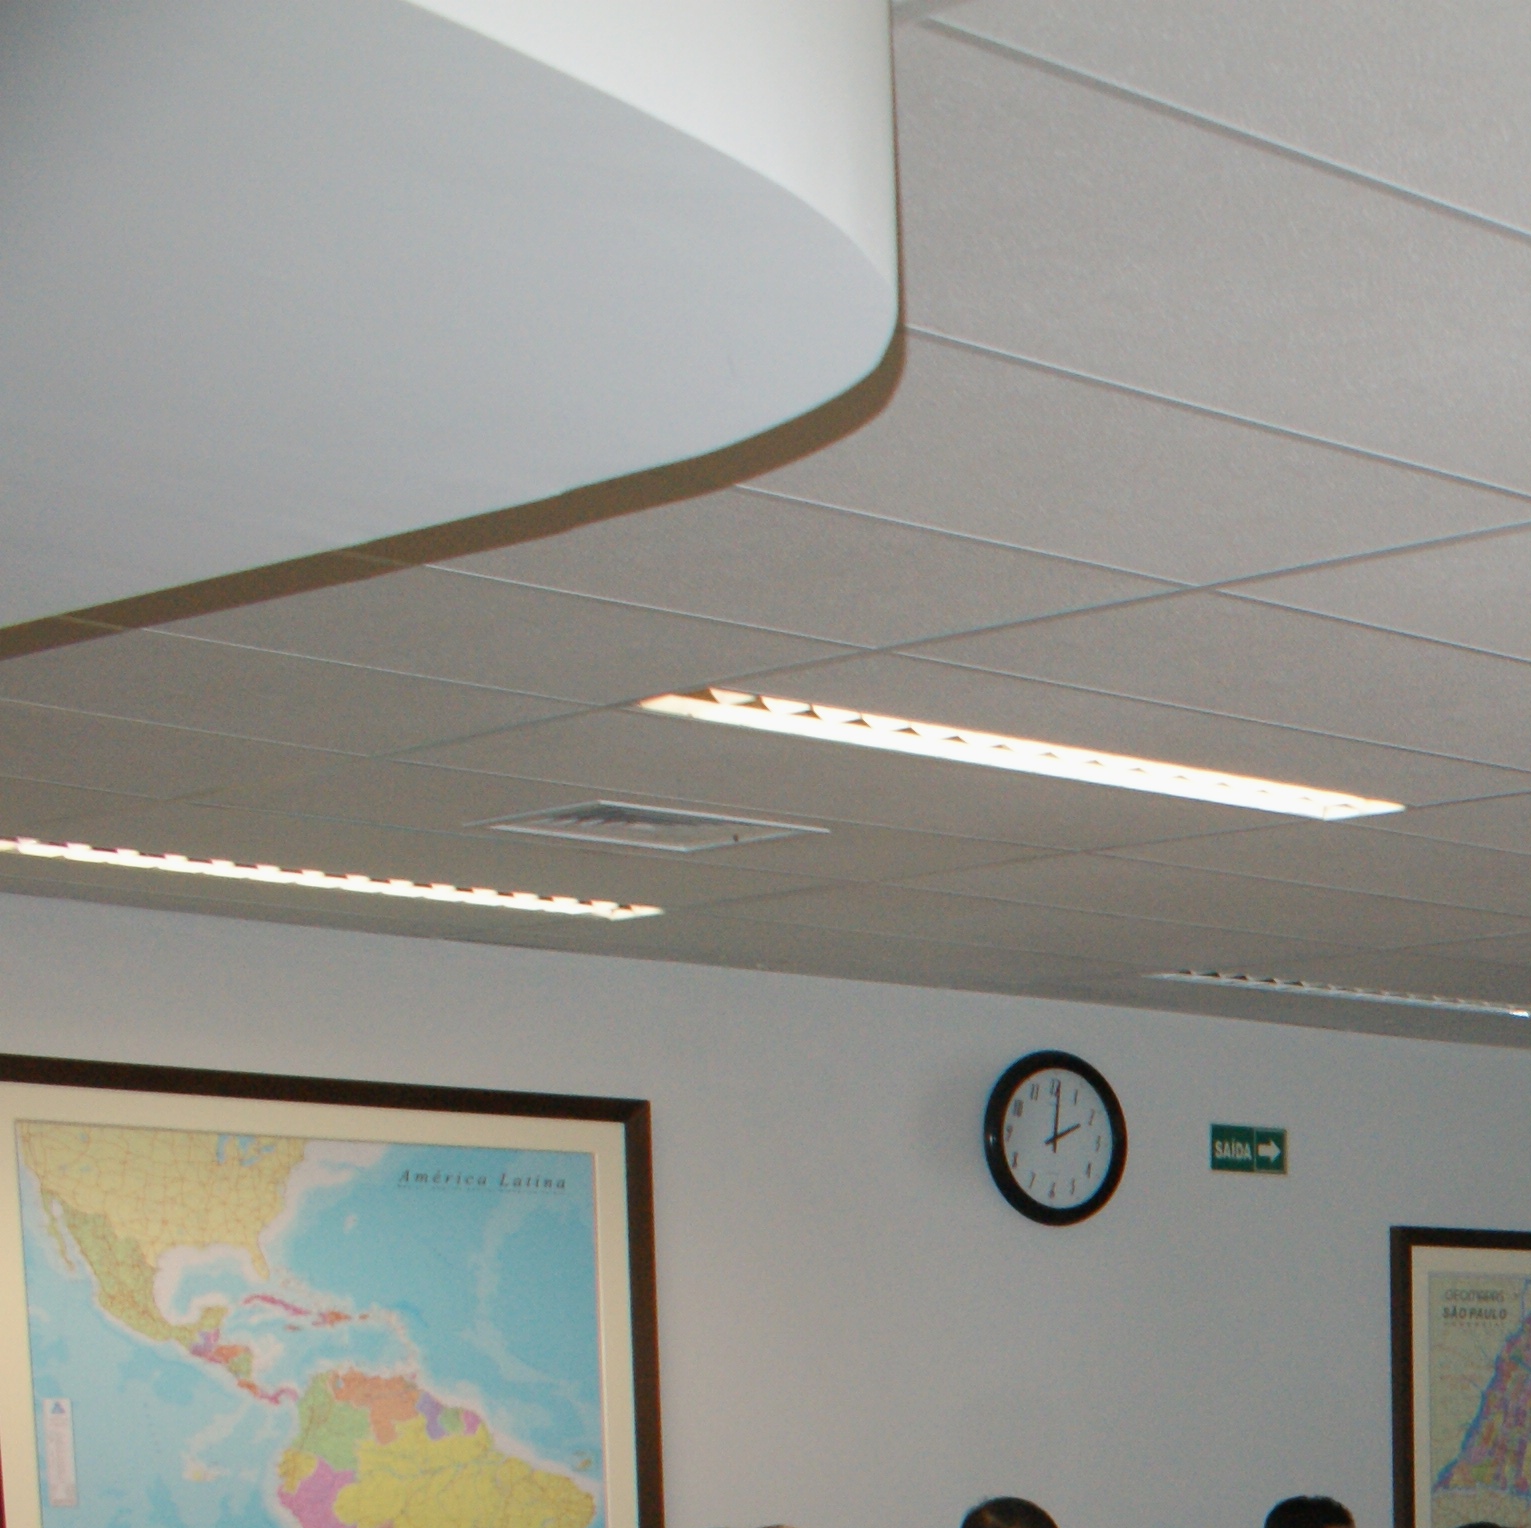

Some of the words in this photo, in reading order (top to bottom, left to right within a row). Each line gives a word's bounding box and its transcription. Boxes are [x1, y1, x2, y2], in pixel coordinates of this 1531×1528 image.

[1214, 1137, 1253, 1160] SAÍDA
[399, 1169, 488, 1186] América
[500, 1172, 566, 1189] Latina
[1469, 1307, 1508, 1320] PAULO
